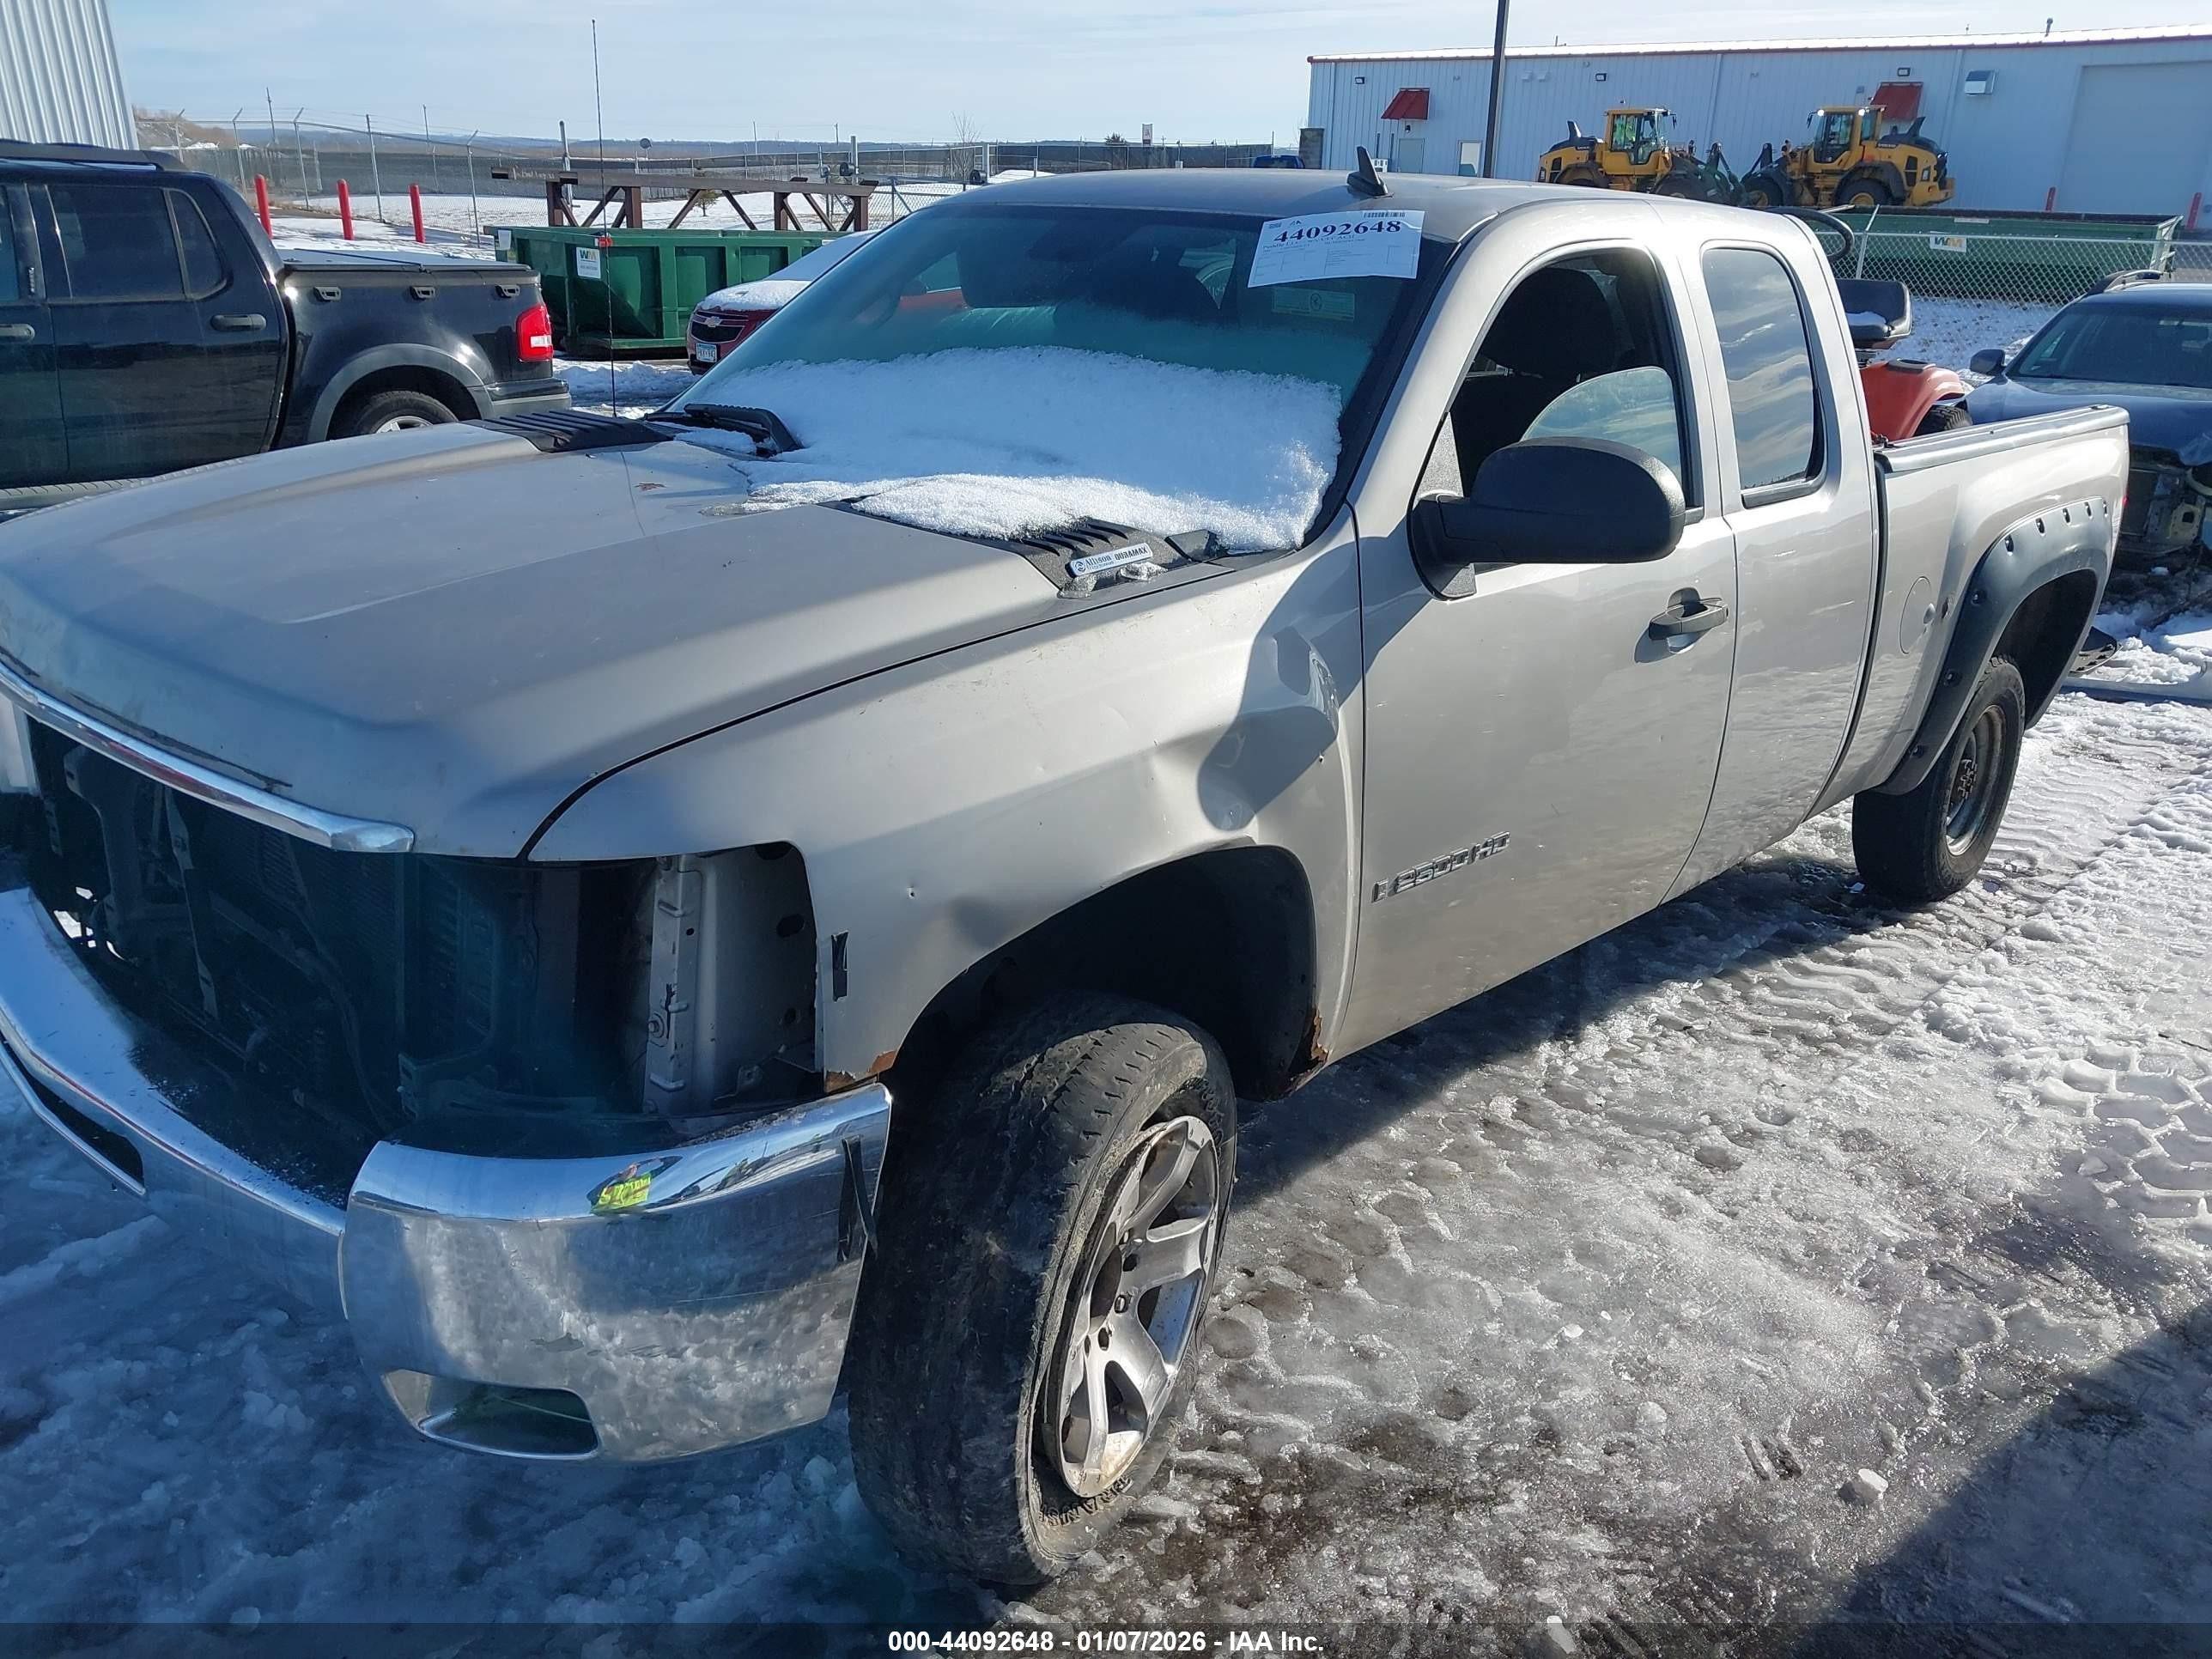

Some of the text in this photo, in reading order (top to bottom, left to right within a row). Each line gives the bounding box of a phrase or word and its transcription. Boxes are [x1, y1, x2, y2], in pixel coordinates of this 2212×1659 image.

[1273, 220, 1401, 242] 44092648
[1115, 546, 1148, 560] DURAMAX
[1085, 555, 1112, 566] Allison
